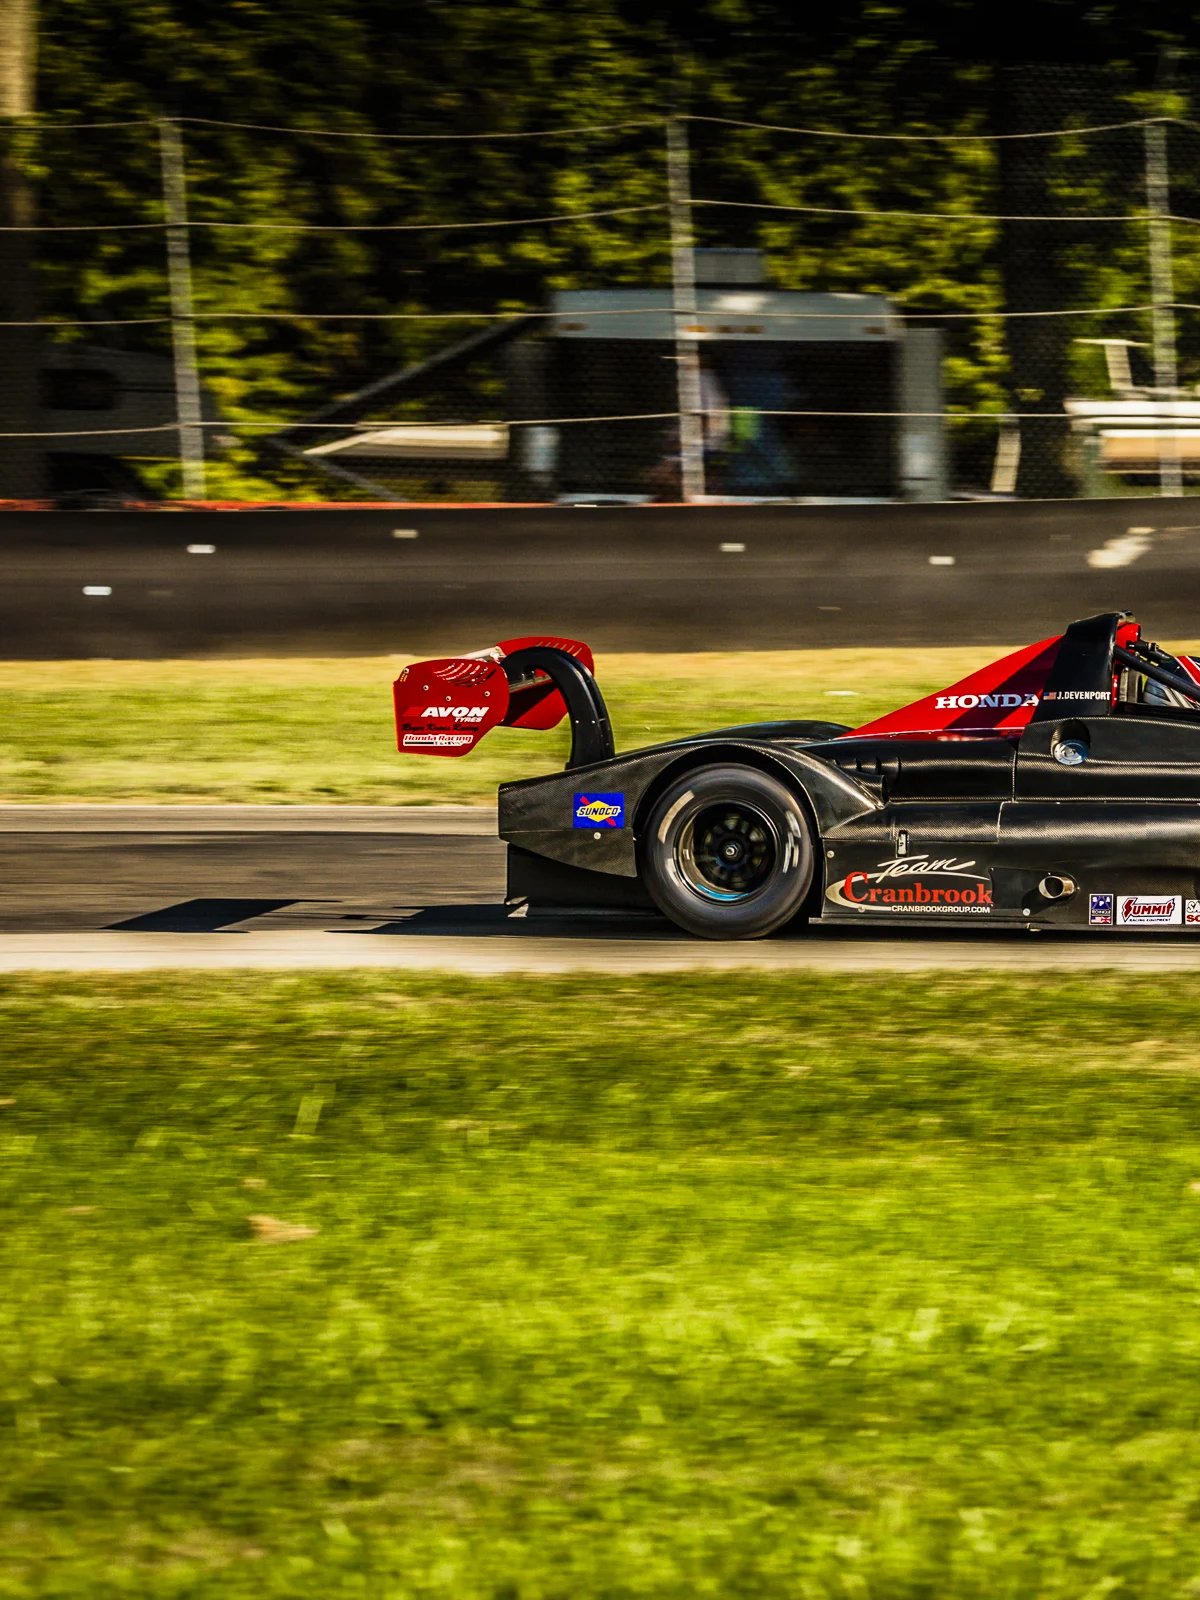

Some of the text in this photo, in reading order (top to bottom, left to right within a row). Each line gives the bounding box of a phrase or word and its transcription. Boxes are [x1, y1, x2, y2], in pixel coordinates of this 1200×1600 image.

[934, 694, 1040, 709] HONDA
[1057, 691, 1112, 701] J.DEVENPORT
[420, 706, 490, 718] AVON
[438, 735, 472, 743] Racing
[578, 807, 619, 816] SUNOCO
[875, 854, 976, 884] Team
[843, 871, 994, 905] Cranbrook
[891, 906, 991, 914] CRANBROOKGROUP.COM
